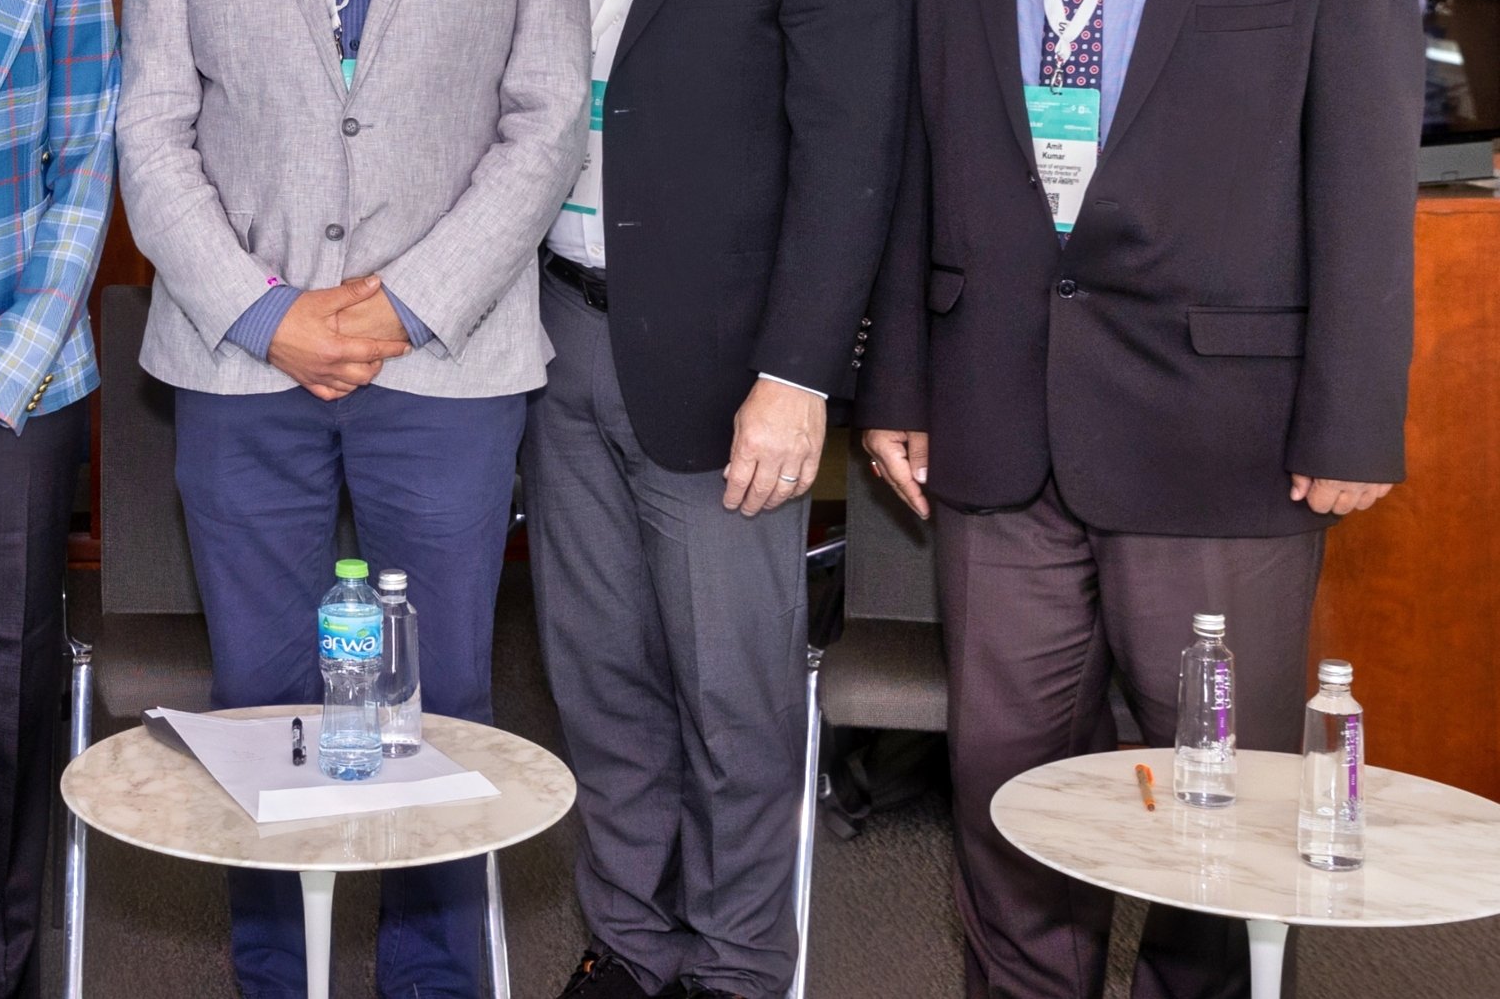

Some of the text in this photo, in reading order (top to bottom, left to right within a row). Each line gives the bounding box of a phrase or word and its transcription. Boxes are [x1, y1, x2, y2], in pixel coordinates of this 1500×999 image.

[1046, 142, 1063, 151] Amit
[1042, 152, 1066, 160] Kumar
[322, 634, 377, 652] arwa
